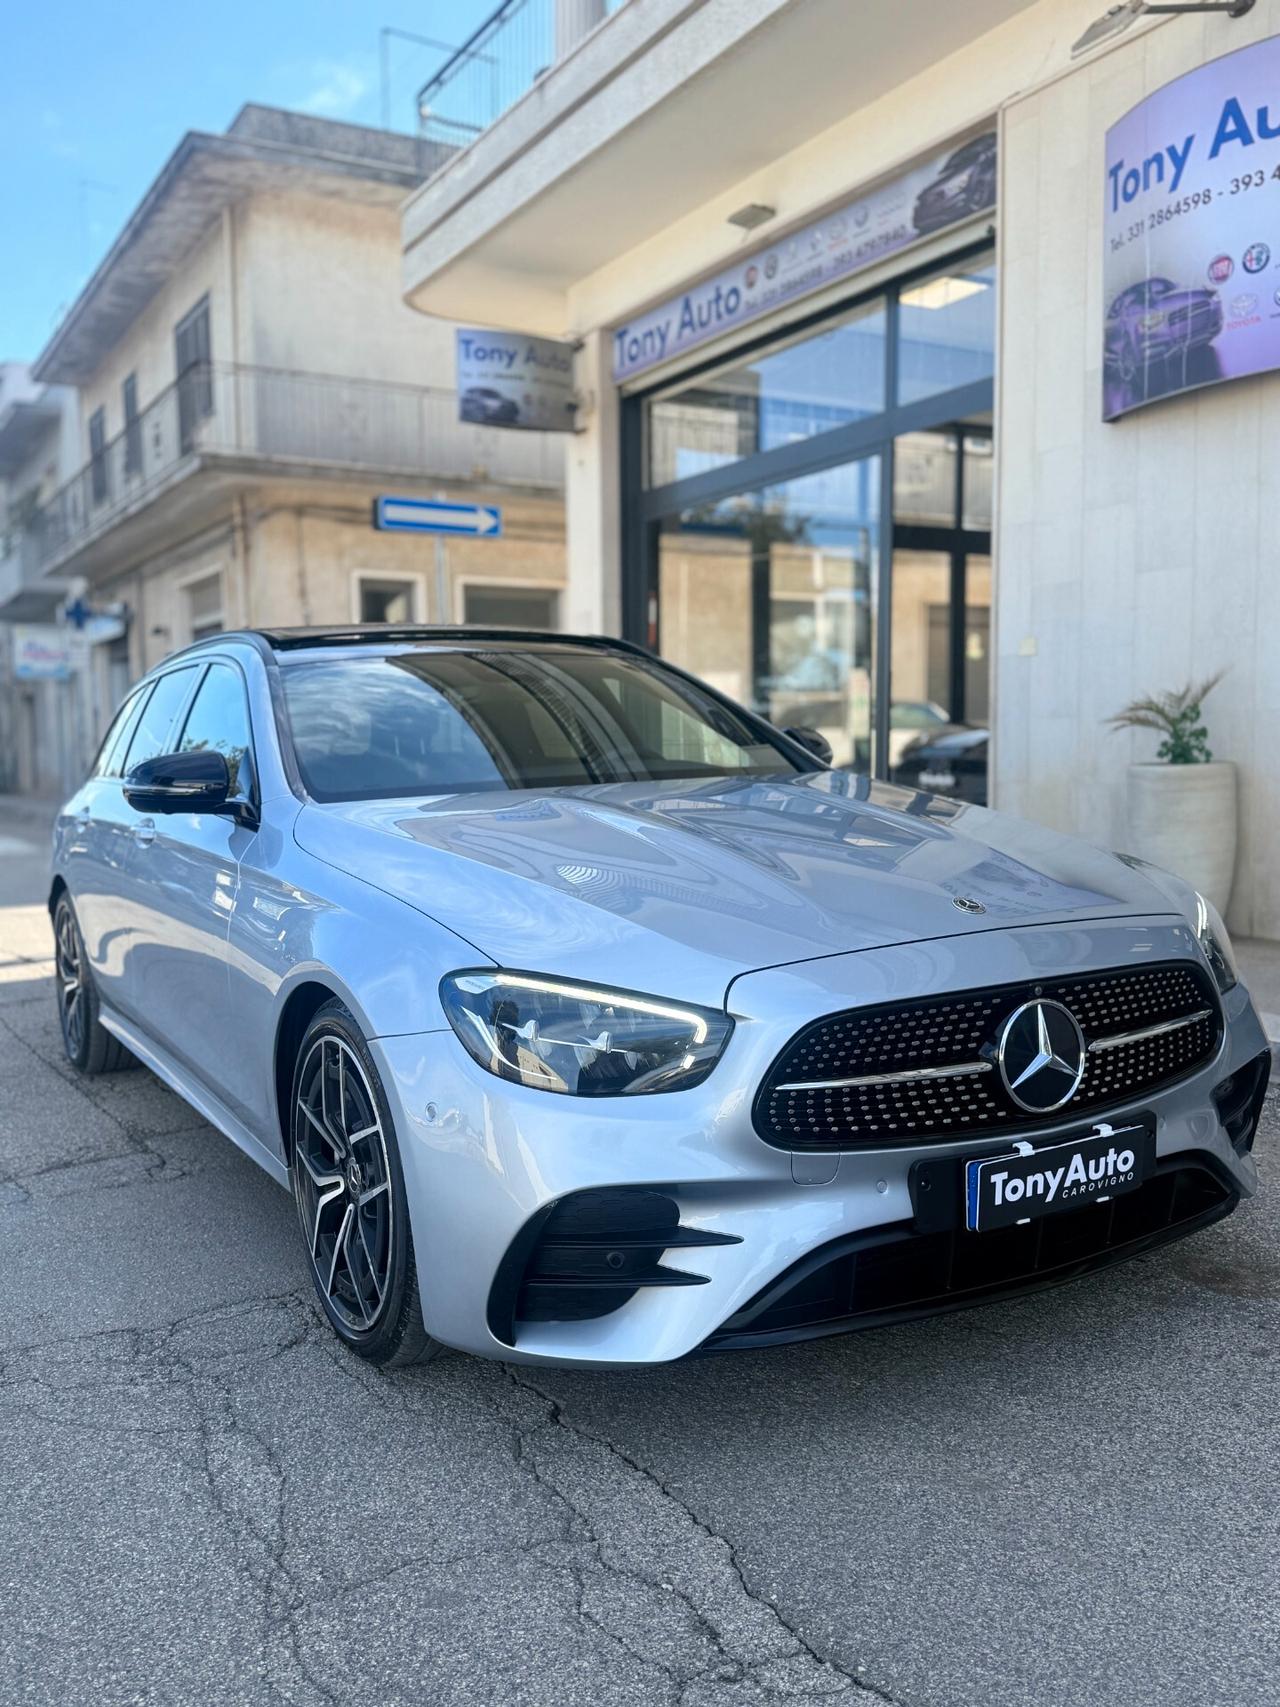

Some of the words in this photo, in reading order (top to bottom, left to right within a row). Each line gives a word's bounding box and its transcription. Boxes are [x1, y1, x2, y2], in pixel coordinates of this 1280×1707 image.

[1109, 133, 1195, 213] Tony
[1148, 188, 1212, 230] 2864598
[1230, 169, 1266, 195] 393
[460, 339, 518, 370] Tony
[523, 343, 572, 374] Auto
[614, 319, 671, 370] Tony
[677, 285, 741, 340] Auto
[990, 1148, 1135, 1206] TonyAuto
[1062, 1171, 1135, 1199] CAROVIGNO
